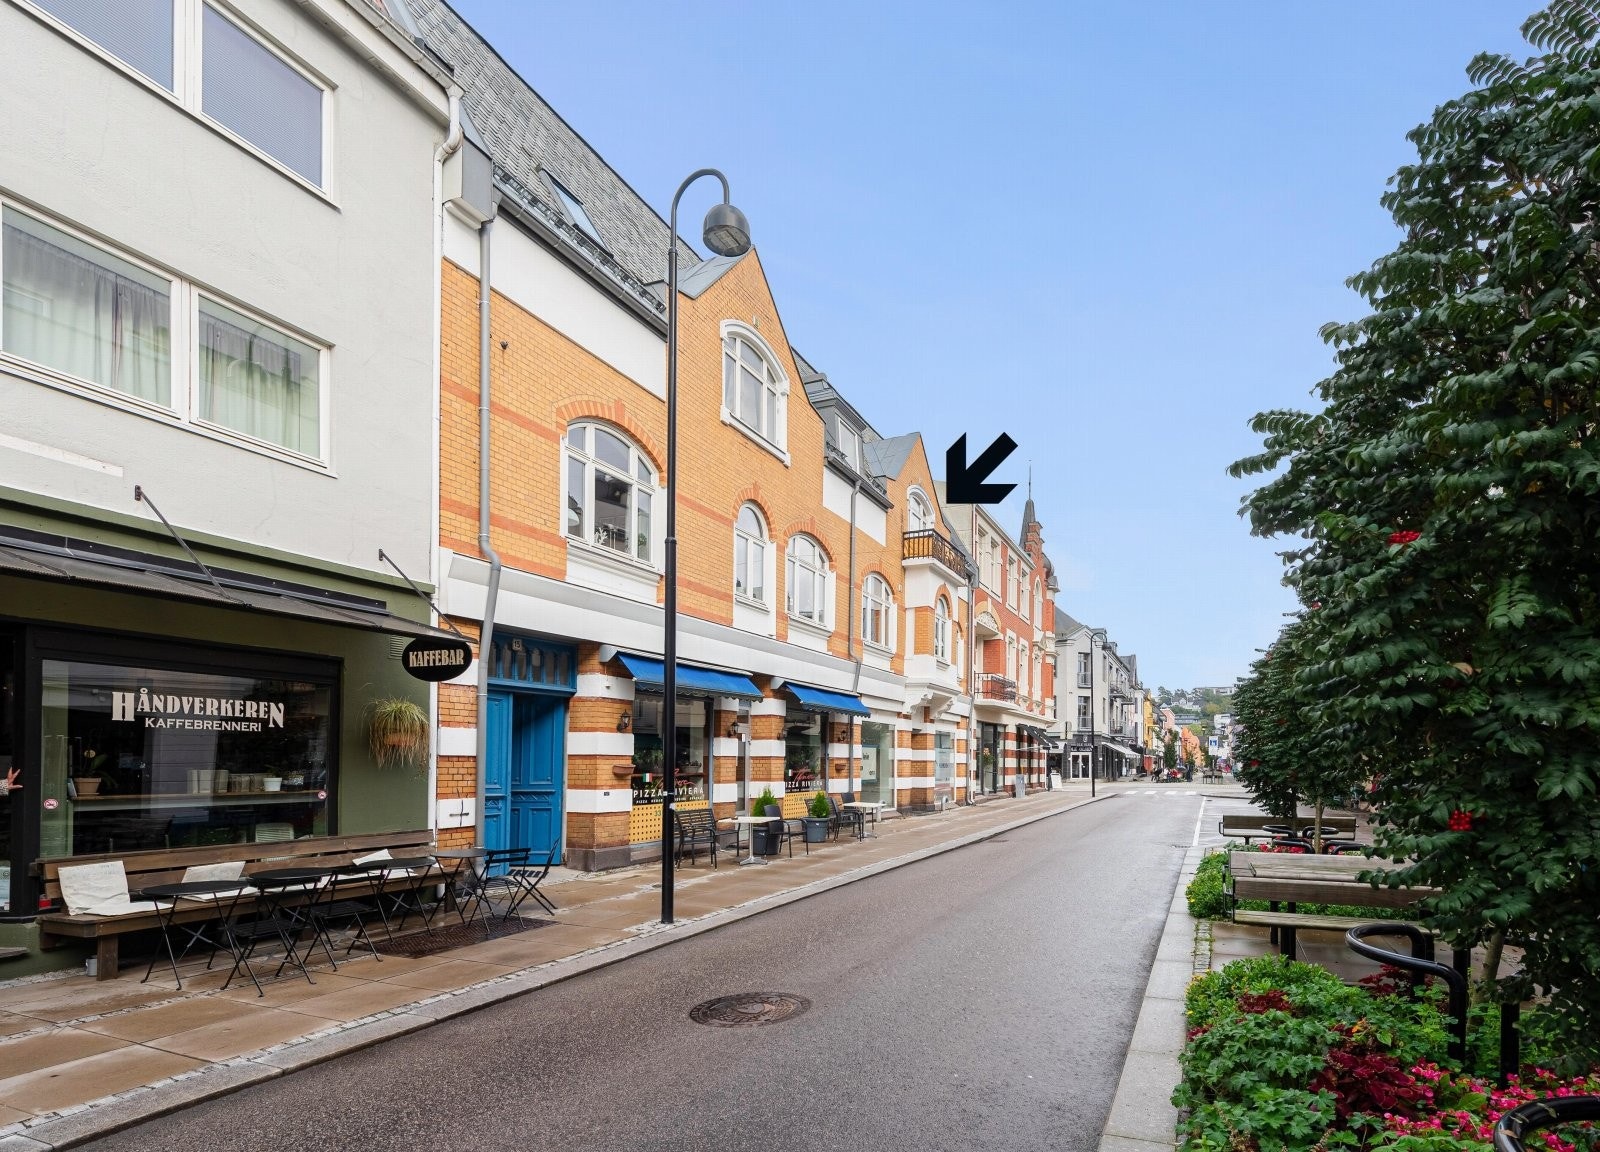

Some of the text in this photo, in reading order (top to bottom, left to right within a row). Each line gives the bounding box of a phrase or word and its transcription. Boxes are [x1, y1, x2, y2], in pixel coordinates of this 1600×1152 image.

[409, 649, 464, 667] KAFFEBAR
[112, 688, 285, 728] HÅNDVERKEREN
[145, 718, 262, 732] KAFFEBRENNERI
[633, 787, 704, 798] PIZZA IVIERA
